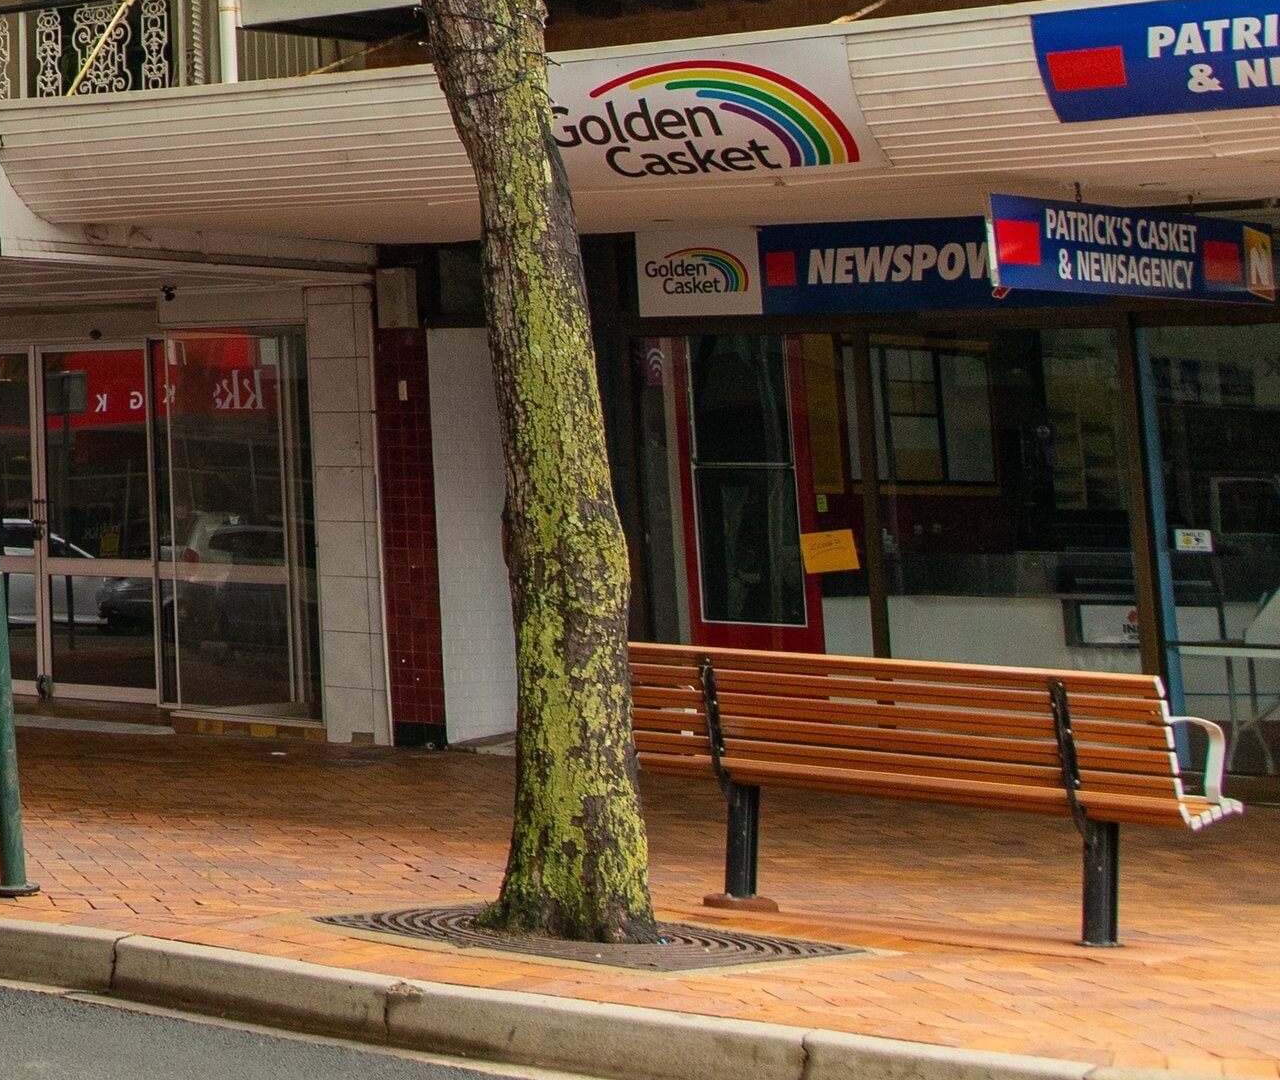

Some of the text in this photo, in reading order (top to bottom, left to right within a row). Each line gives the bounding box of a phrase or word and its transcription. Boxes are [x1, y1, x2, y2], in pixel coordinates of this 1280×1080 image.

[1147, 14, 1279, 58] PATRI
[1187, 63, 1224, 93] &
[551, 98, 723, 148] Golden
[605, 139, 782, 178] Casket
[1045, 208, 1197, 254] PATRICK'S CASKET
[645, 258, 707, 279] Golden
[807, 242, 989, 286] NEWSPOW
[1058, 247, 1193, 290] & NEWSAGENCY
[662, 277, 721, 295] Casket
